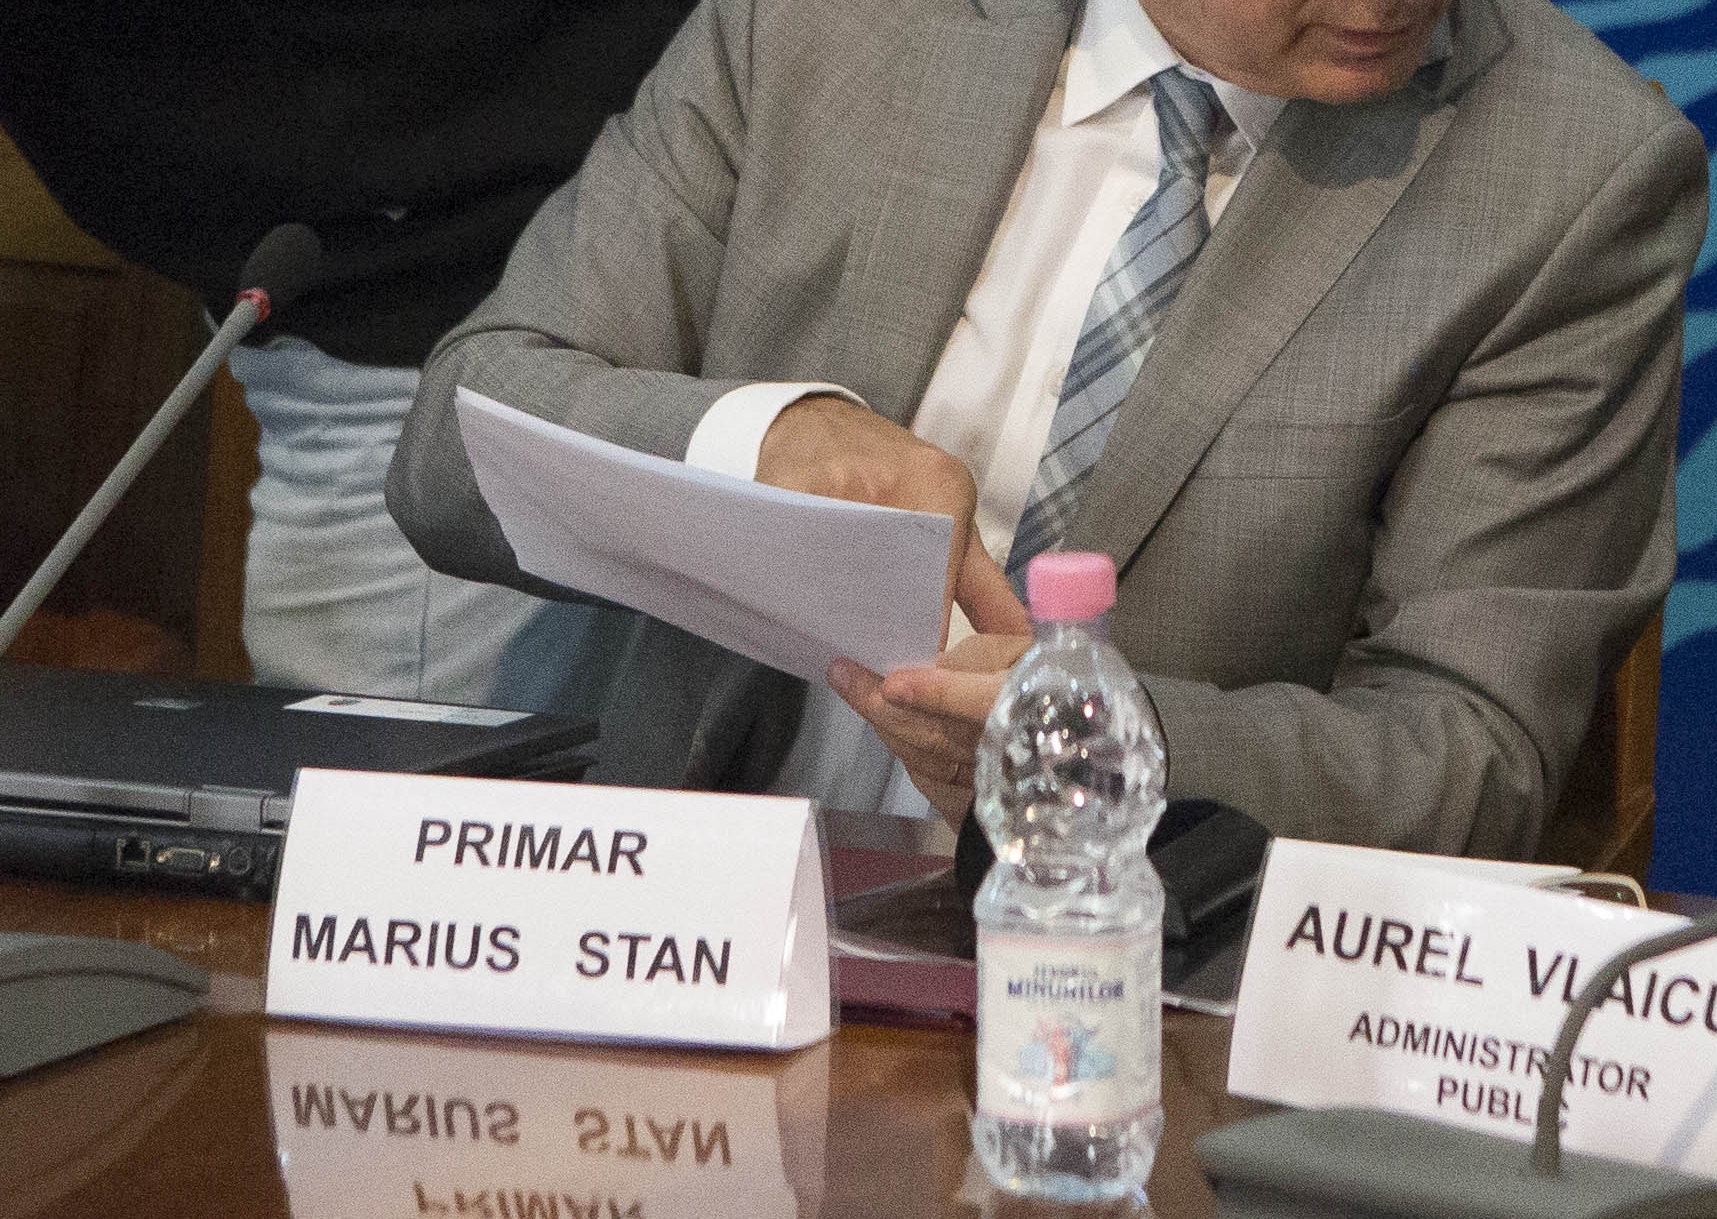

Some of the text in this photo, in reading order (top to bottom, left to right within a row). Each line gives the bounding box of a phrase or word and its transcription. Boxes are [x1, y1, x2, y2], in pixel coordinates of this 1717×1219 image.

[414, 818, 649, 876] PRIMAR
[291, 913, 732, 986] MARIUS STAN
[1285, 902, 1484, 986] AUREL
[1435, 1076, 1569, 1131] PUBL
